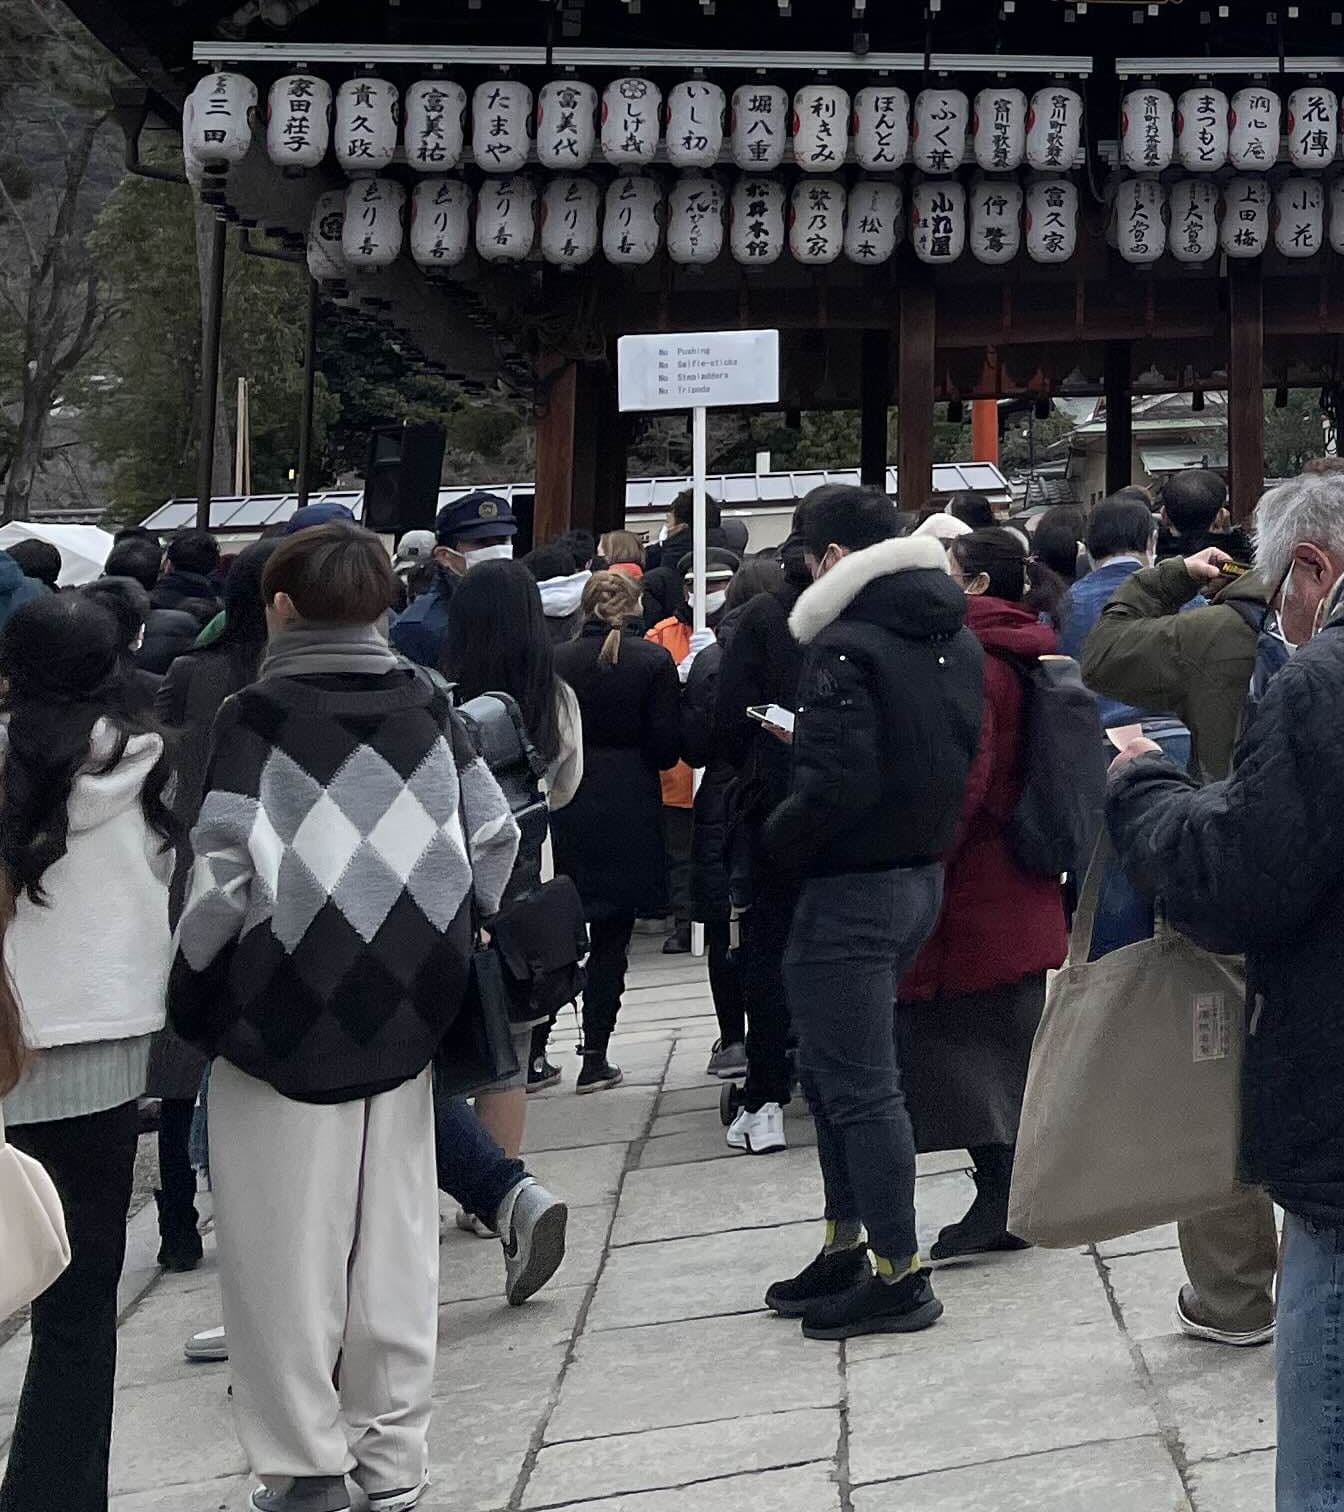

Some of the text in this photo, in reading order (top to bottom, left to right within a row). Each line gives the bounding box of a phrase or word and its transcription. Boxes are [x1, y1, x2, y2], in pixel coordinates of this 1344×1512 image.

[347, 83, 377, 159] 貴久政
[485, 88, 513, 163] たまや
[681, 86, 711, 152] いし初
[747, 94, 774, 163] 堀八重
[810, 96, 836, 162] 利きみ
[872, 95, 897, 163] ほんとん
[926, 99, 958, 170] ふく葉
[1195, 94, 1217, 162] まつもと
[1289, 190, 1316, 248] 小花
